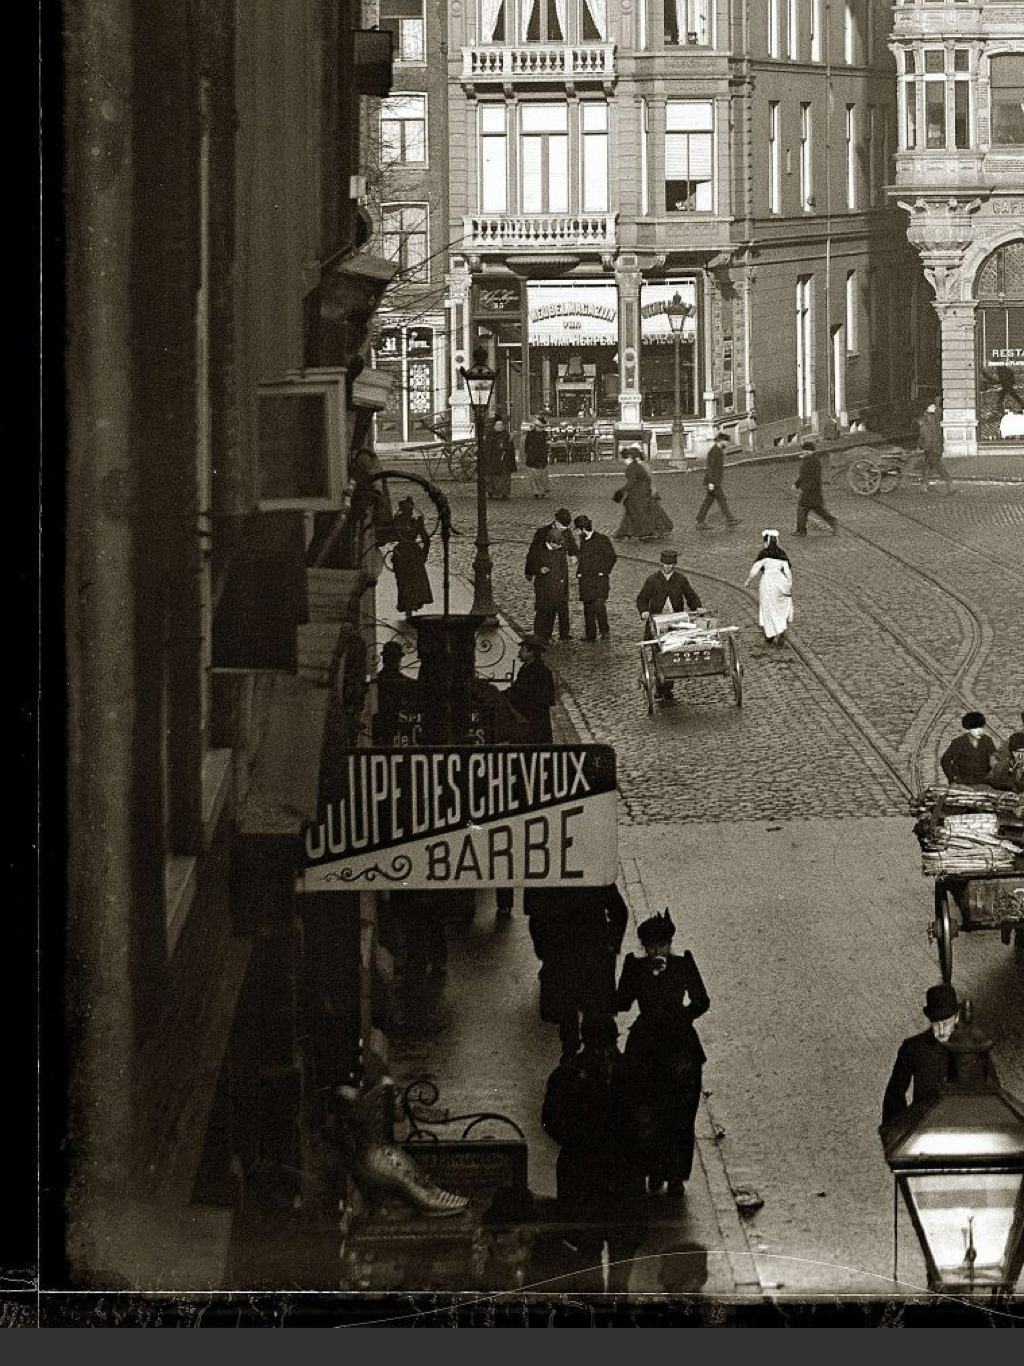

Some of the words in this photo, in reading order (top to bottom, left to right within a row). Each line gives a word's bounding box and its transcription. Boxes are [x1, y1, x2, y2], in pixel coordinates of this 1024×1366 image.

[411, 753, 462, 835] DES
[468, 751, 592, 820] CHEVEUX
[425, 805, 585, 881] BARBE
